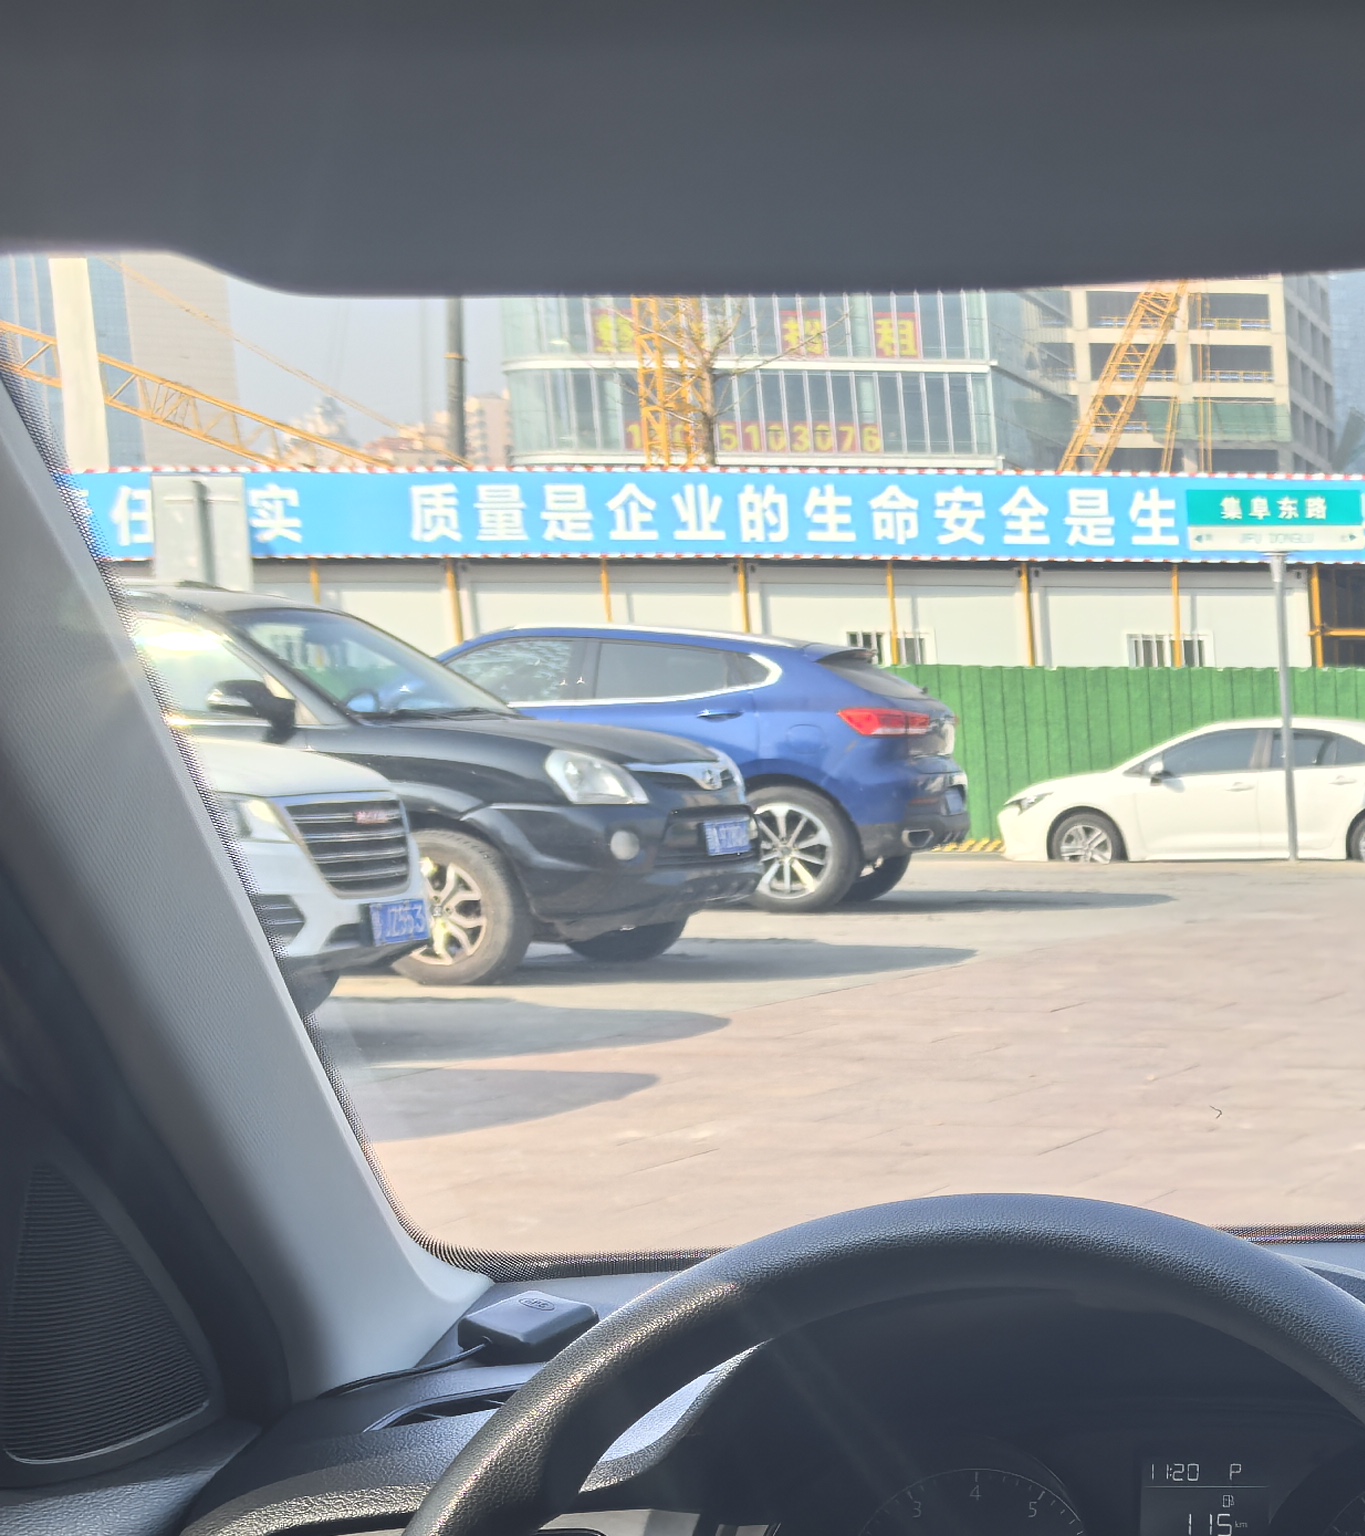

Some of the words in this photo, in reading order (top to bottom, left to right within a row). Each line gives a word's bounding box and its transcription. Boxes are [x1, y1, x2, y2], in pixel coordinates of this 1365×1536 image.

[1151, 1463, 1200, 1482] 11:20
[1229, 1463, 1242, 1481] P
[969, 1485, 982, 1501] 4
[912, 1501, 922, 1518] 3
[1028, 1501, 1038, 1518] 5
